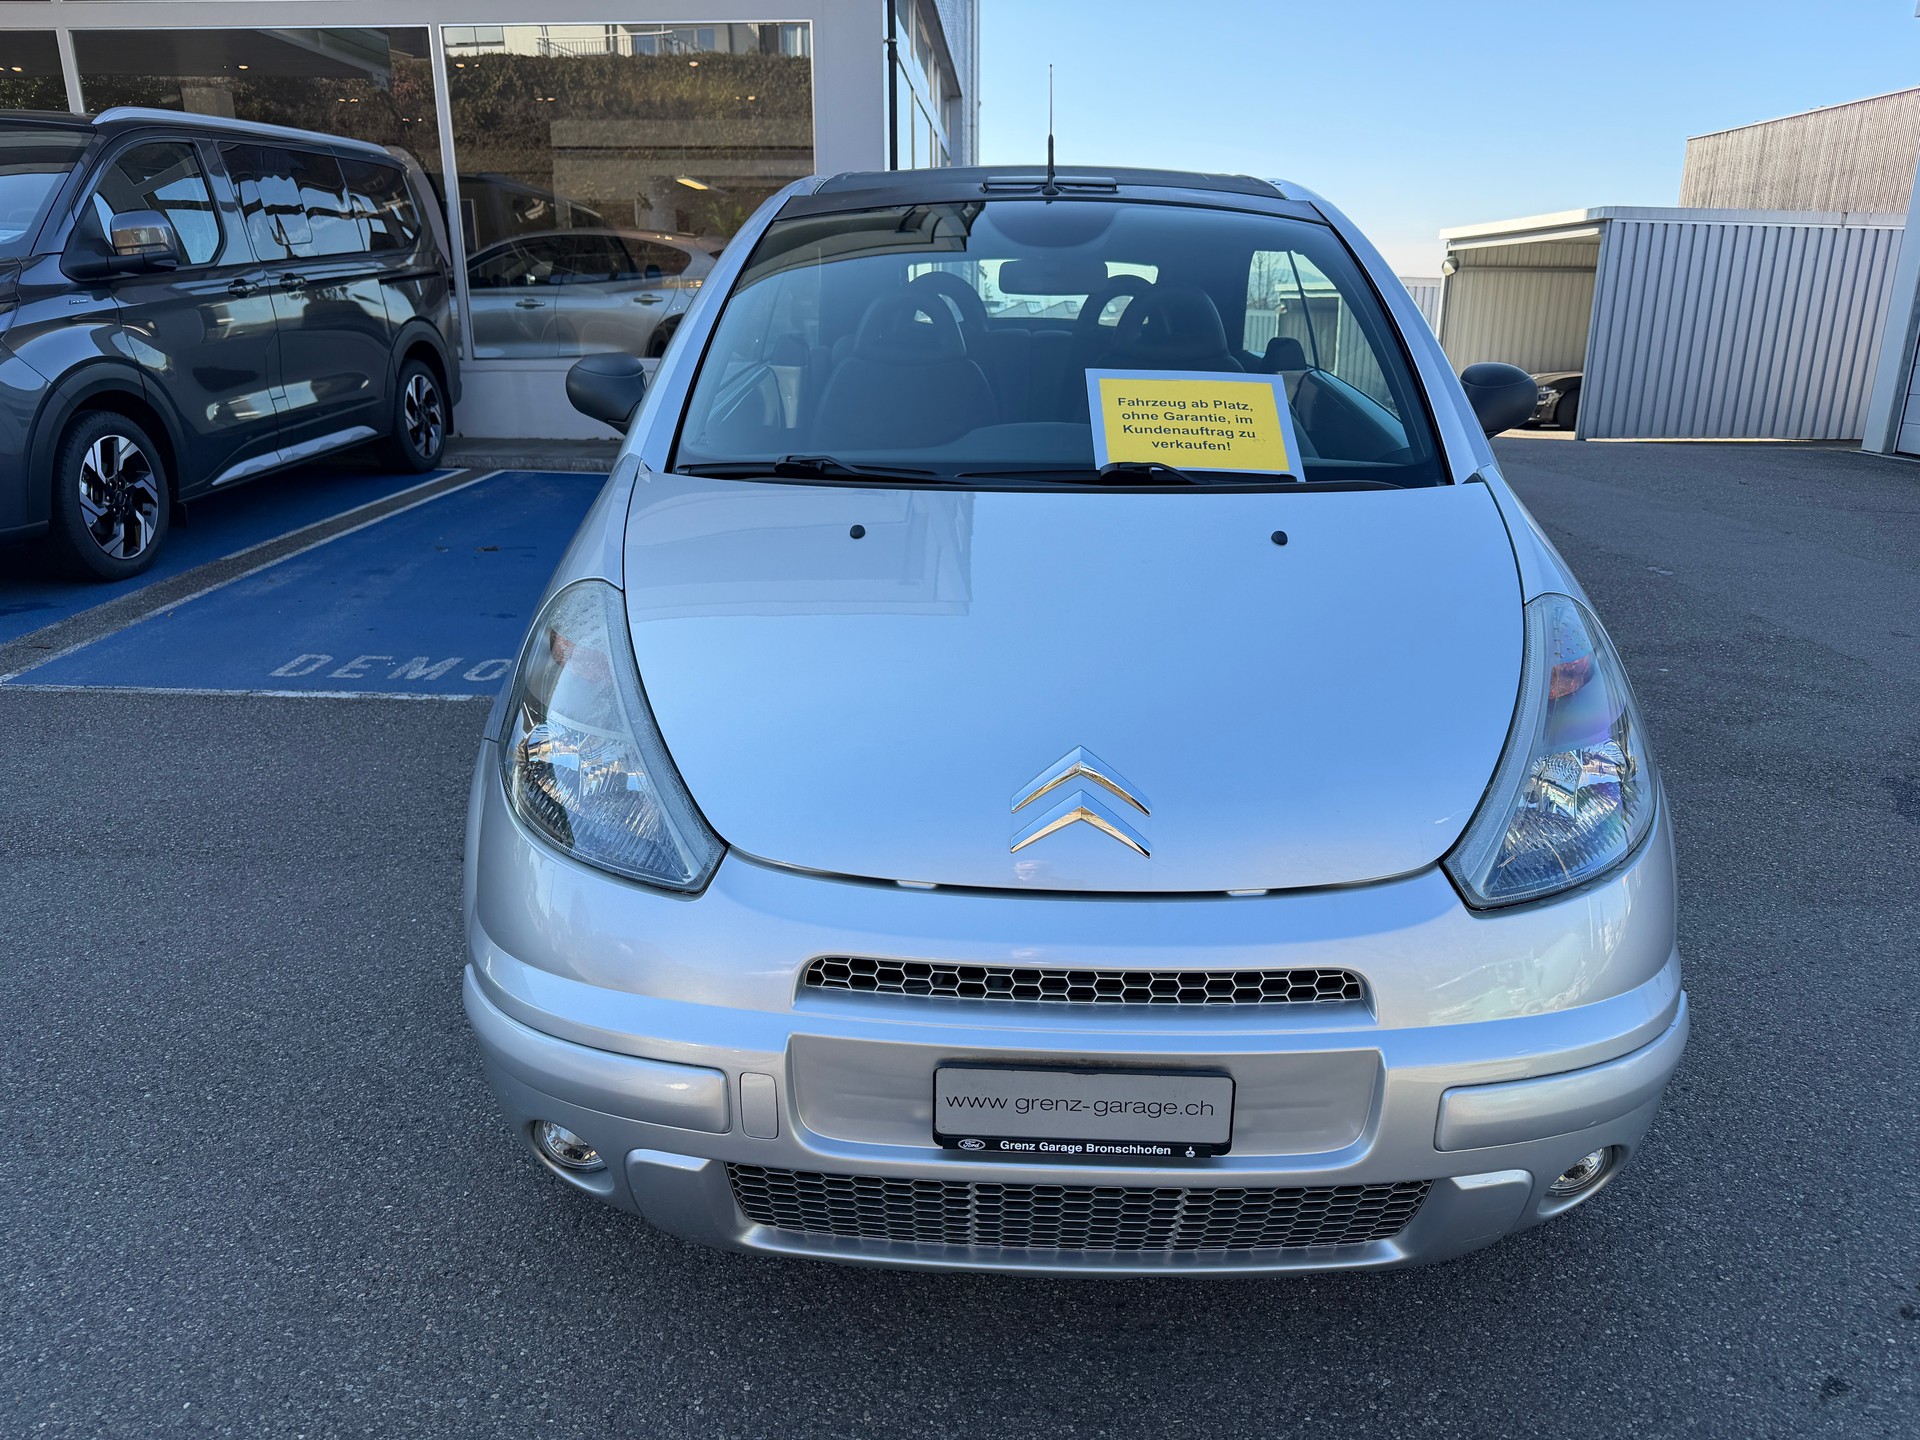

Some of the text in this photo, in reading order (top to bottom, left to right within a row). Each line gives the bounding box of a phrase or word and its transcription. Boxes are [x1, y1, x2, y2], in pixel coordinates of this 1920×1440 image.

[1118, 397, 1254, 412] Fahrzeug ab Platz,
[1121, 411, 1253, 425] ohne Garantie, im
[1123, 424, 1256, 439] Kundenauftrag zu
[1151, 439, 1232, 451] verkaufen!
[269, 654, 512, 682] DEMO
[1000, 1140, 1171, 1155] Grenz Garage Bronschhofen
